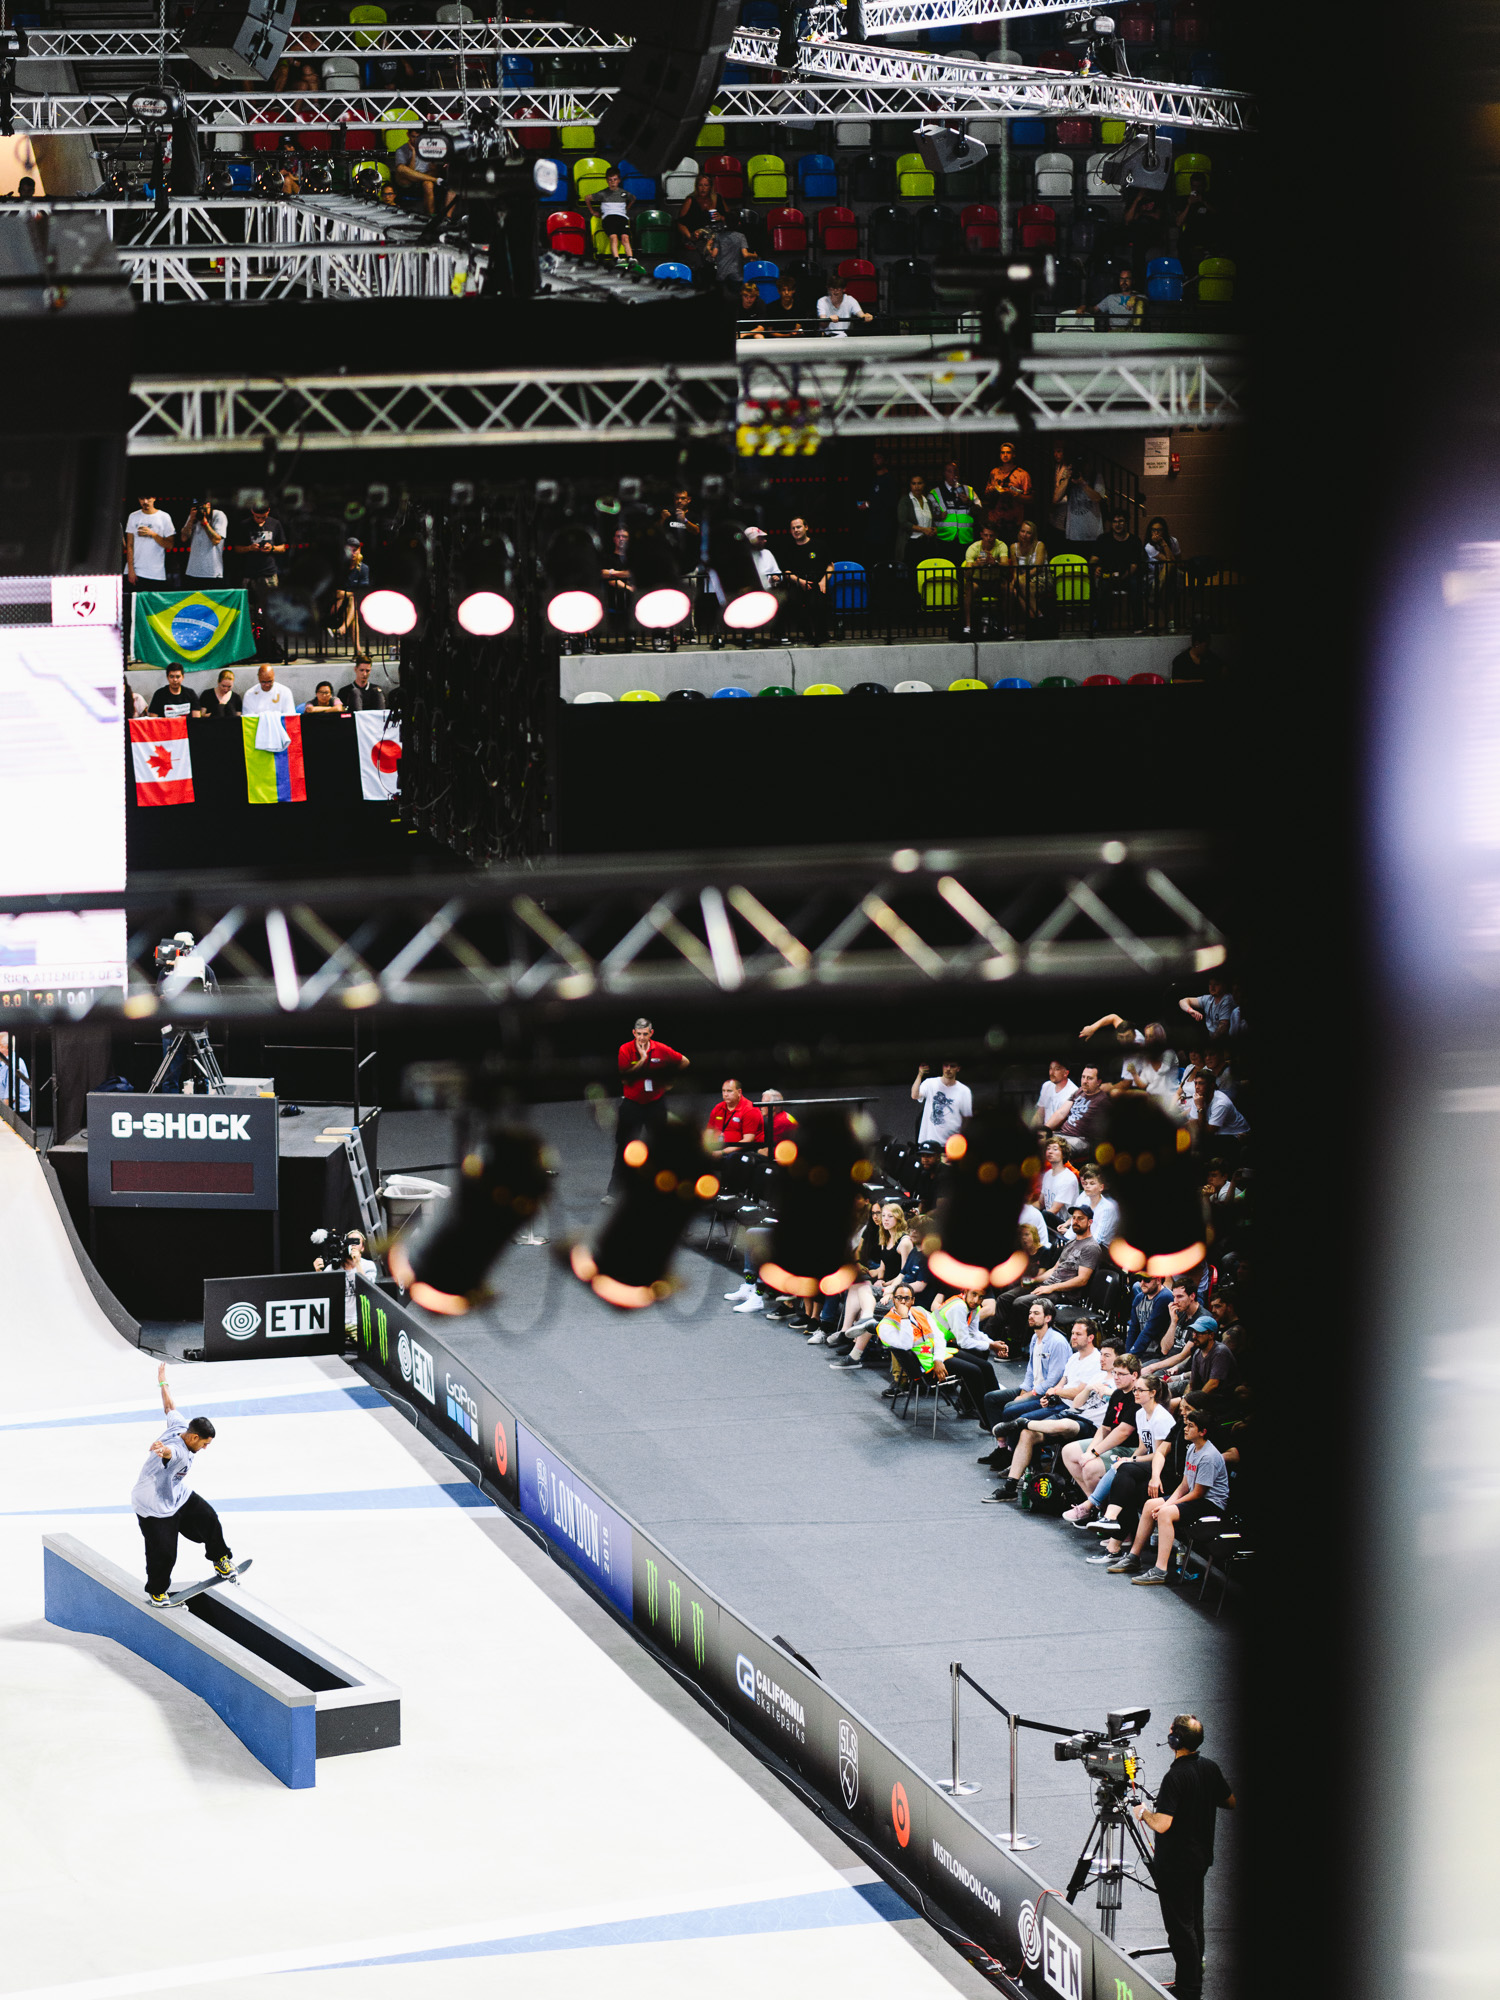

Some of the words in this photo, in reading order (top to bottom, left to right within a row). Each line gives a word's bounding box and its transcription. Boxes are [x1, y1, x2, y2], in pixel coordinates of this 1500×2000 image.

[111, 1111, 251, 1141] G-SHOCK
[271, 1303, 325, 1332] ETN
[413, 1347, 433, 1397] ETN
[445, 1372, 478, 1420] GoPro
[550, 1471, 600, 1567] LONDON
[602, 1525, 610, 1575] 2018
[756, 1669, 806, 1728] CALIFORNIA
[756, 1693, 806, 1744] skateparks
[840, 1725, 858, 1765] SLS
[932, 1838, 1001, 1917] VISITLONDON.COM
[1046, 1927, 1079, 2000] ETN
